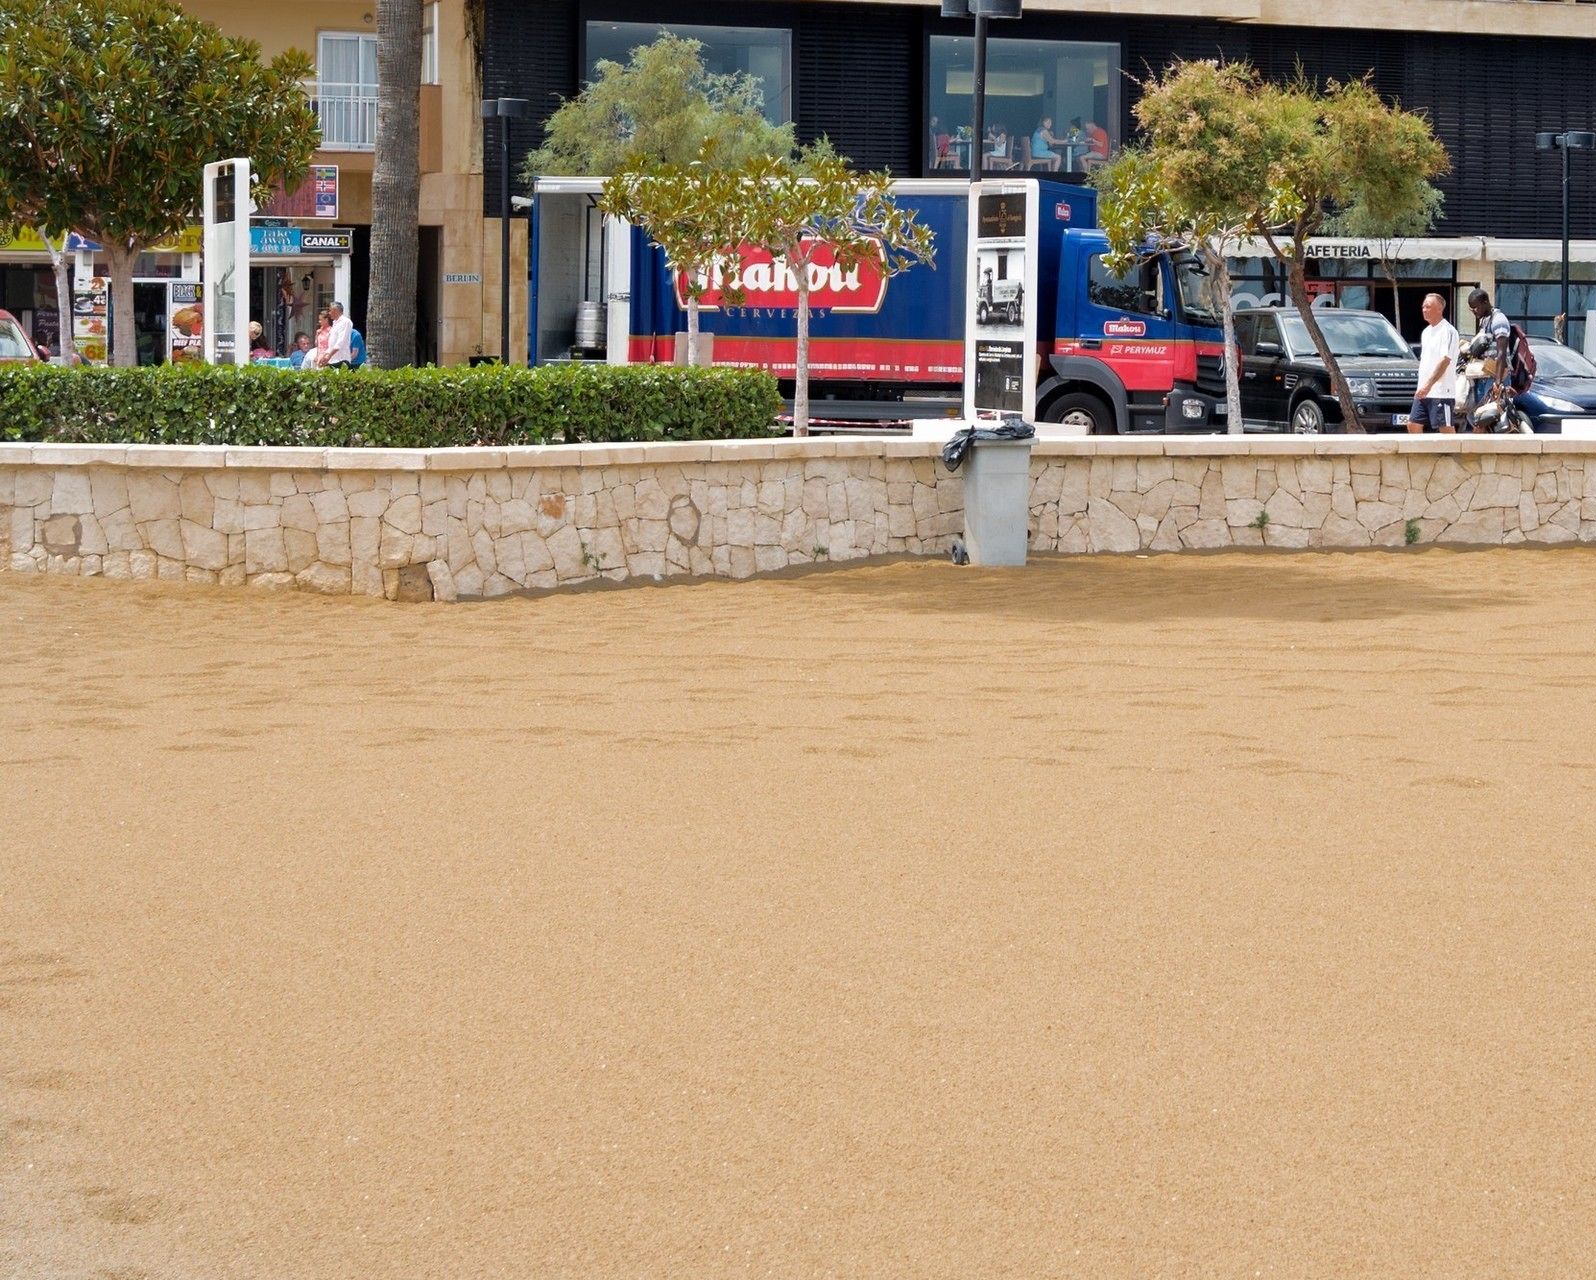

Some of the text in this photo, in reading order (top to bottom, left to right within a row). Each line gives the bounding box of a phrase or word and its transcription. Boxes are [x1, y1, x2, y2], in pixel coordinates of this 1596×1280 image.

[304, 236, 348, 246] CANAL+
[1303, 245, 1371, 257] AFETERIA
[446, 274, 480, 282] BERLIN
[726, 308, 826, 318] CERVEZAS
[1109, 324, 1142, 333] Mahou
[1125, 345, 1167, 354] PERYMUZ
